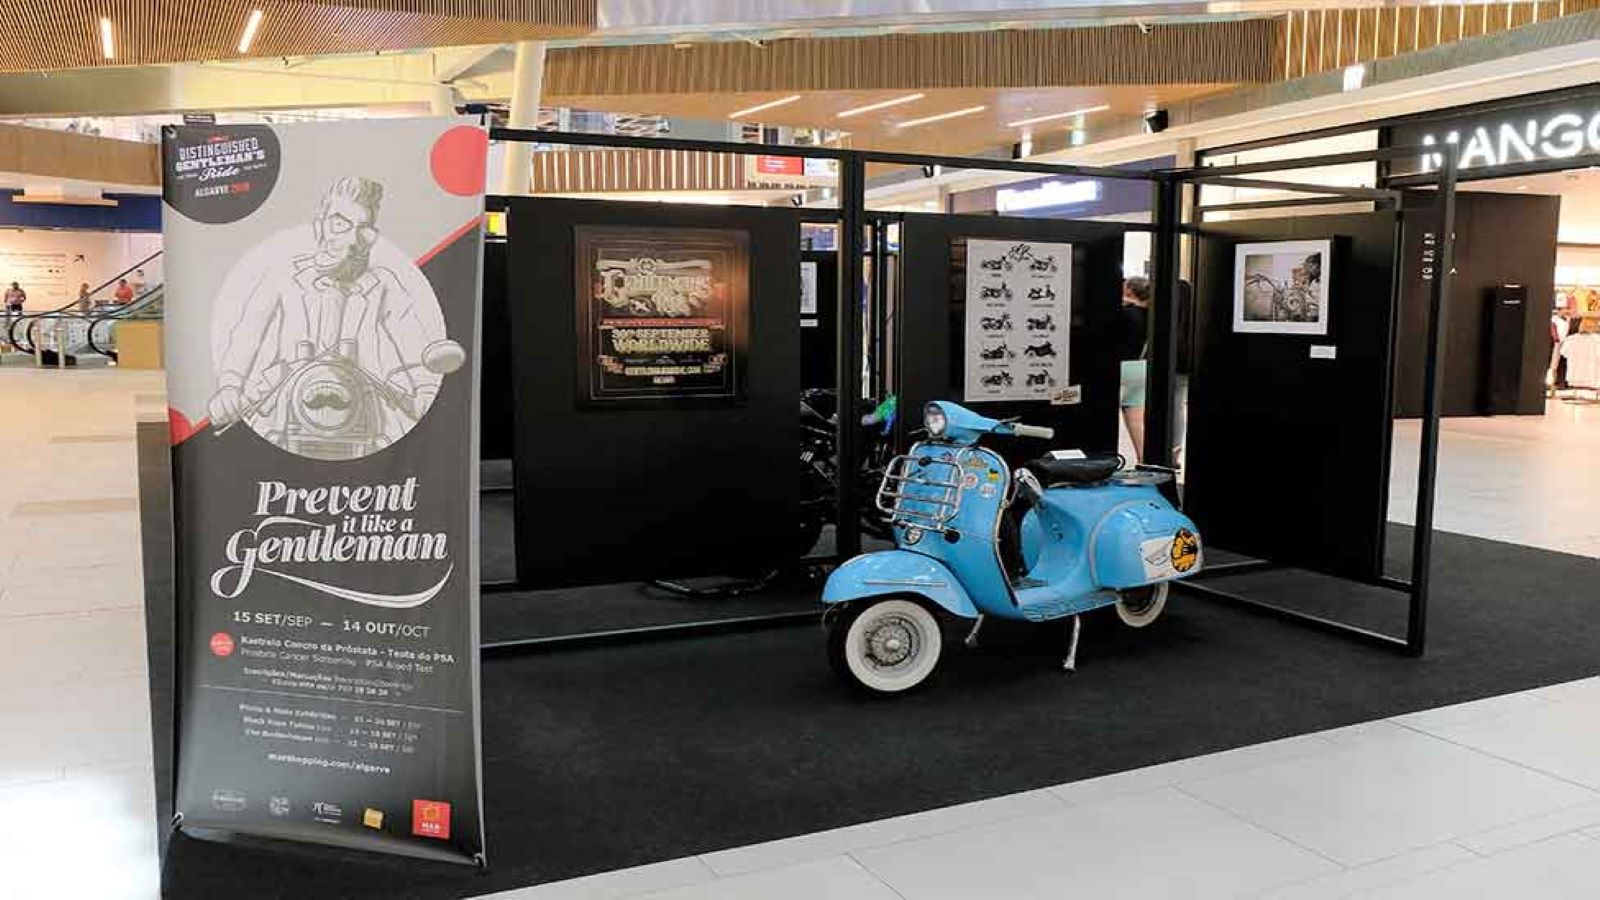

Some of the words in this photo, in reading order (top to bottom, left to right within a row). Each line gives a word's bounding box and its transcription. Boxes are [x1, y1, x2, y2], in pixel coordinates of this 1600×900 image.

[175, 149, 265, 172] GENTLEMAN'S
[179, 137, 258, 161] DISTINGUISHED
[198, 165, 240, 181] Ride
[611, 338, 710, 354] WORLDWIDE
[253, 476, 420, 516] Prevent
[342, 515, 357, 533] it
[361, 514, 397, 533] like
[400, 517, 414, 533] a
[210, 516, 450, 599] Gentleman
[233, 610, 251, 623] 15
[255, 611, 313, 627] SET/SEP
[343, 619, 361, 632] 14
[365, 621, 432, 638] OUT/OCT
[433, 652, 455, 664] PSA
